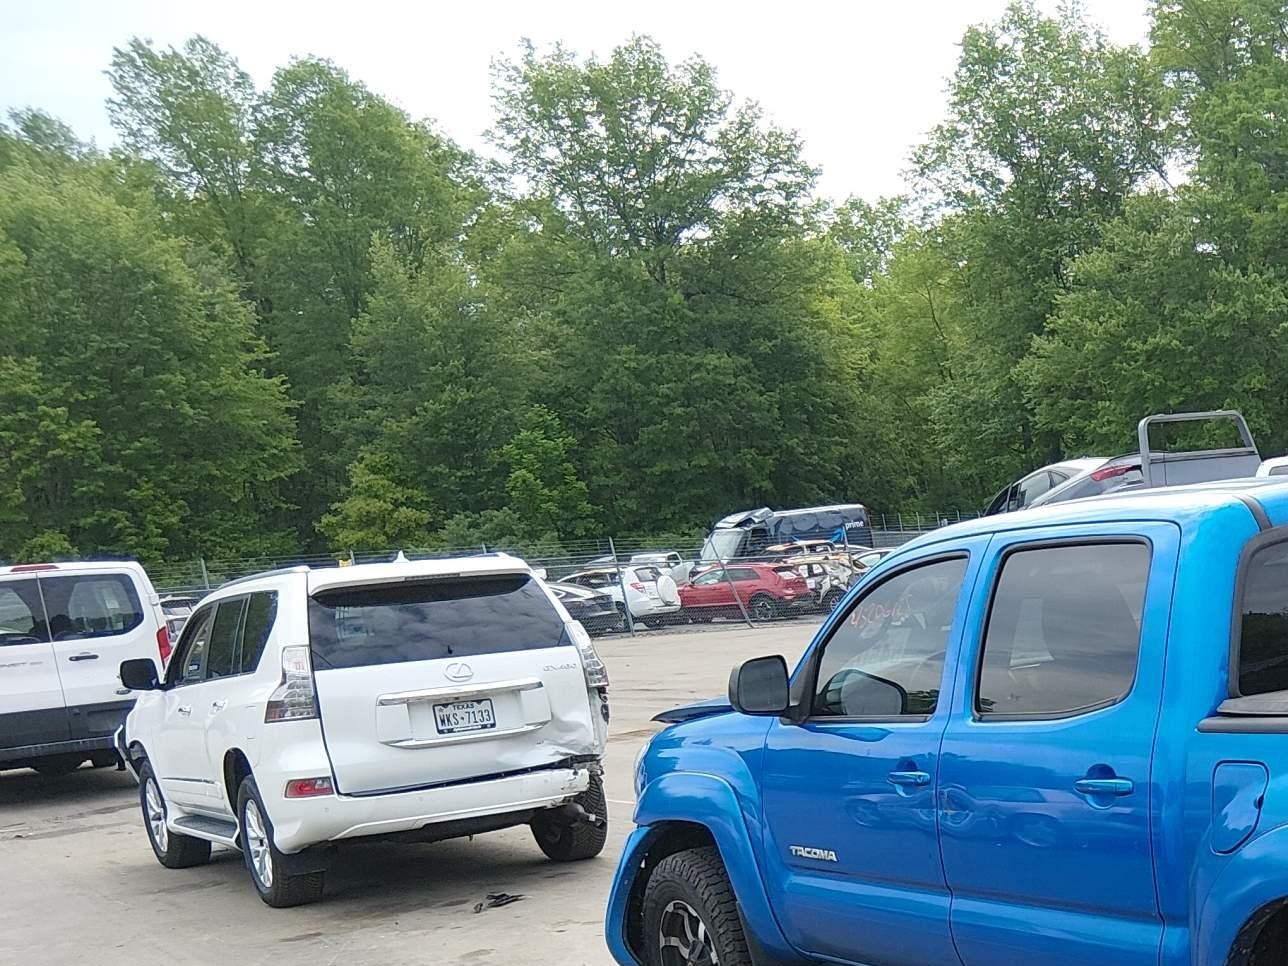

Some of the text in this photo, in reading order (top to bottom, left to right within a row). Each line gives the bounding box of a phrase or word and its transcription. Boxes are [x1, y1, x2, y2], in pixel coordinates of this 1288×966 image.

[845, 520, 864, 531] prime
[453, 703, 475, 711] TEXAS
[789, 845, 838, 862] TACOMA
